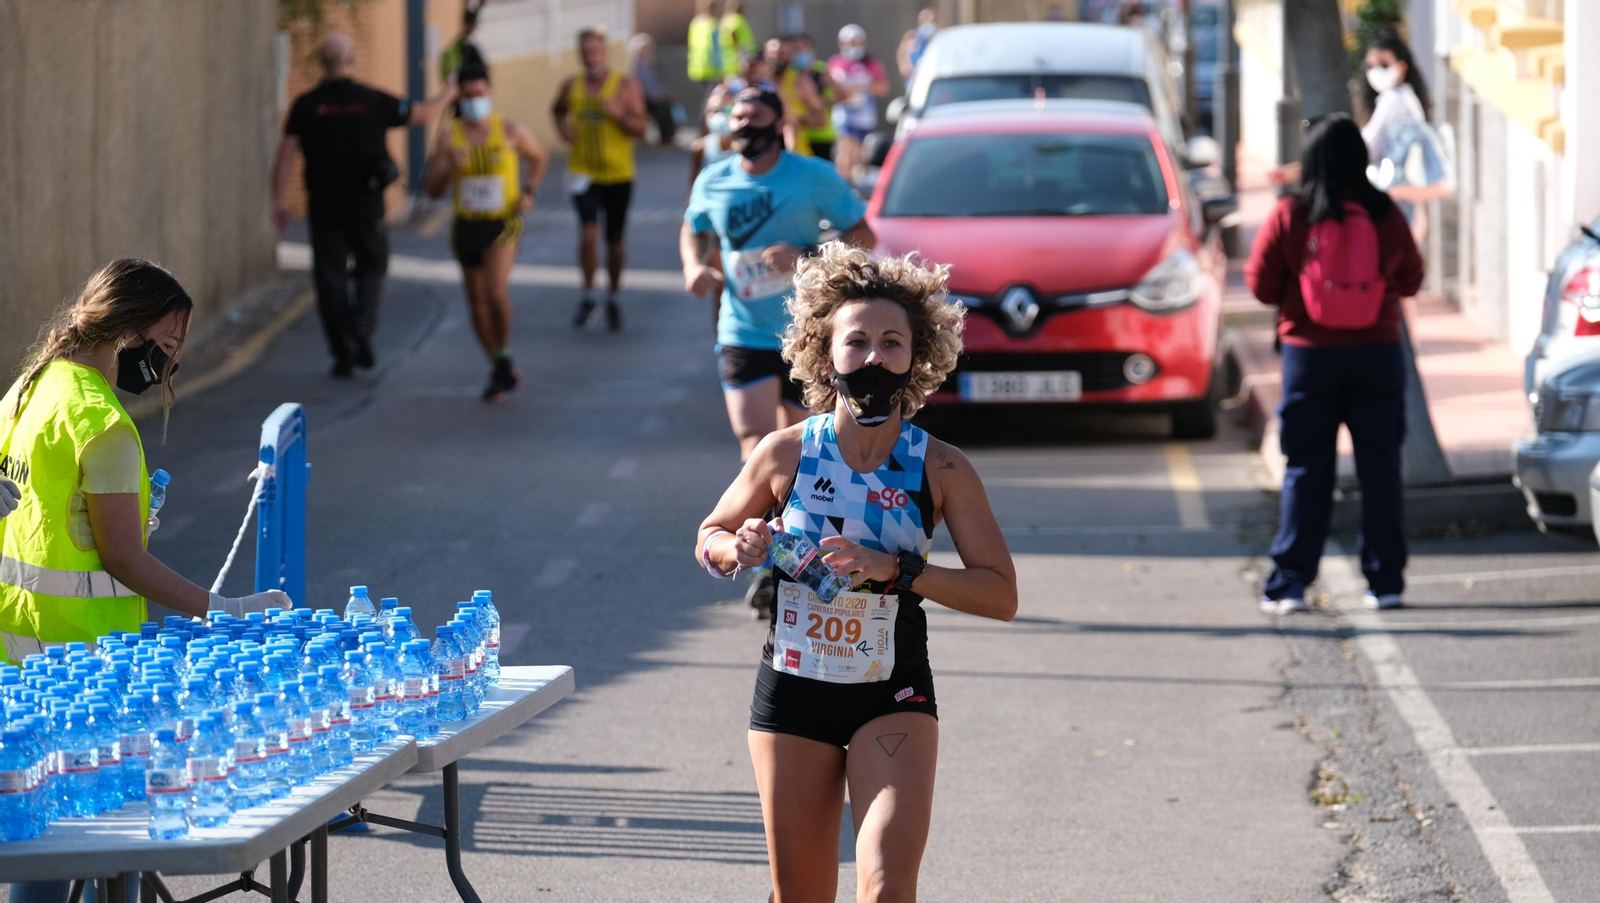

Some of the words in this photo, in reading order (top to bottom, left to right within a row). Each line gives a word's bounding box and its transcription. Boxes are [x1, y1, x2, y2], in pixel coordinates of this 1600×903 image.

[728, 190, 774, 230] RUN
[811, 493, 834, 503] mobel
[866, 487, 909, 511] ego
[786, 612, 796, 623] SN
[807, 603, 834, 616] CARRERAS
[834, 607, 865, 618] POPULARES
[806, 613, 862, 644] 209
[811, 641, 854, 658] VIRGINIA
[877, 628, 885, 655] RIOJA
